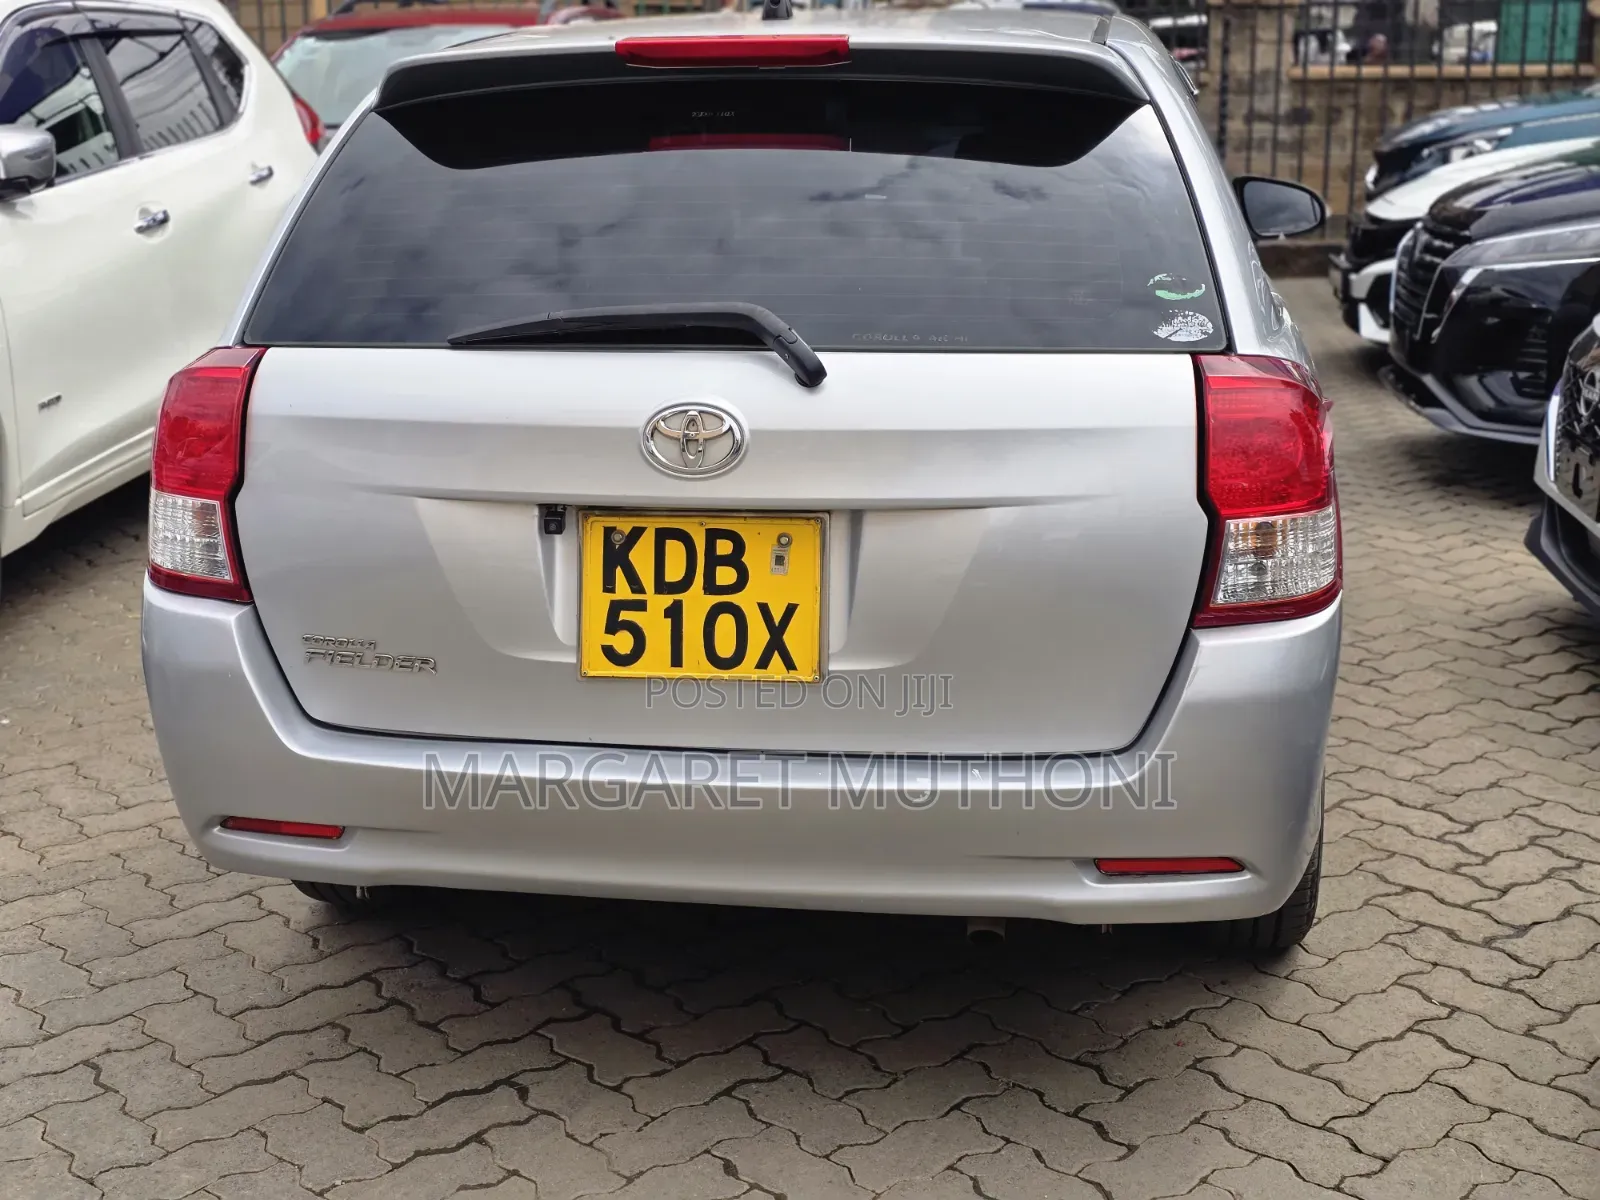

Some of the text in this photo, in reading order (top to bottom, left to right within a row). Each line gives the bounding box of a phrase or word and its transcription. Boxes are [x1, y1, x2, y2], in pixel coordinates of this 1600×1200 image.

[602, 526, 750, 596] KDB
[302, 634, 377, 651] COROLLA
[600, 598, 800, 672] 510X
[304, 648, 438, 676] FIELDER
